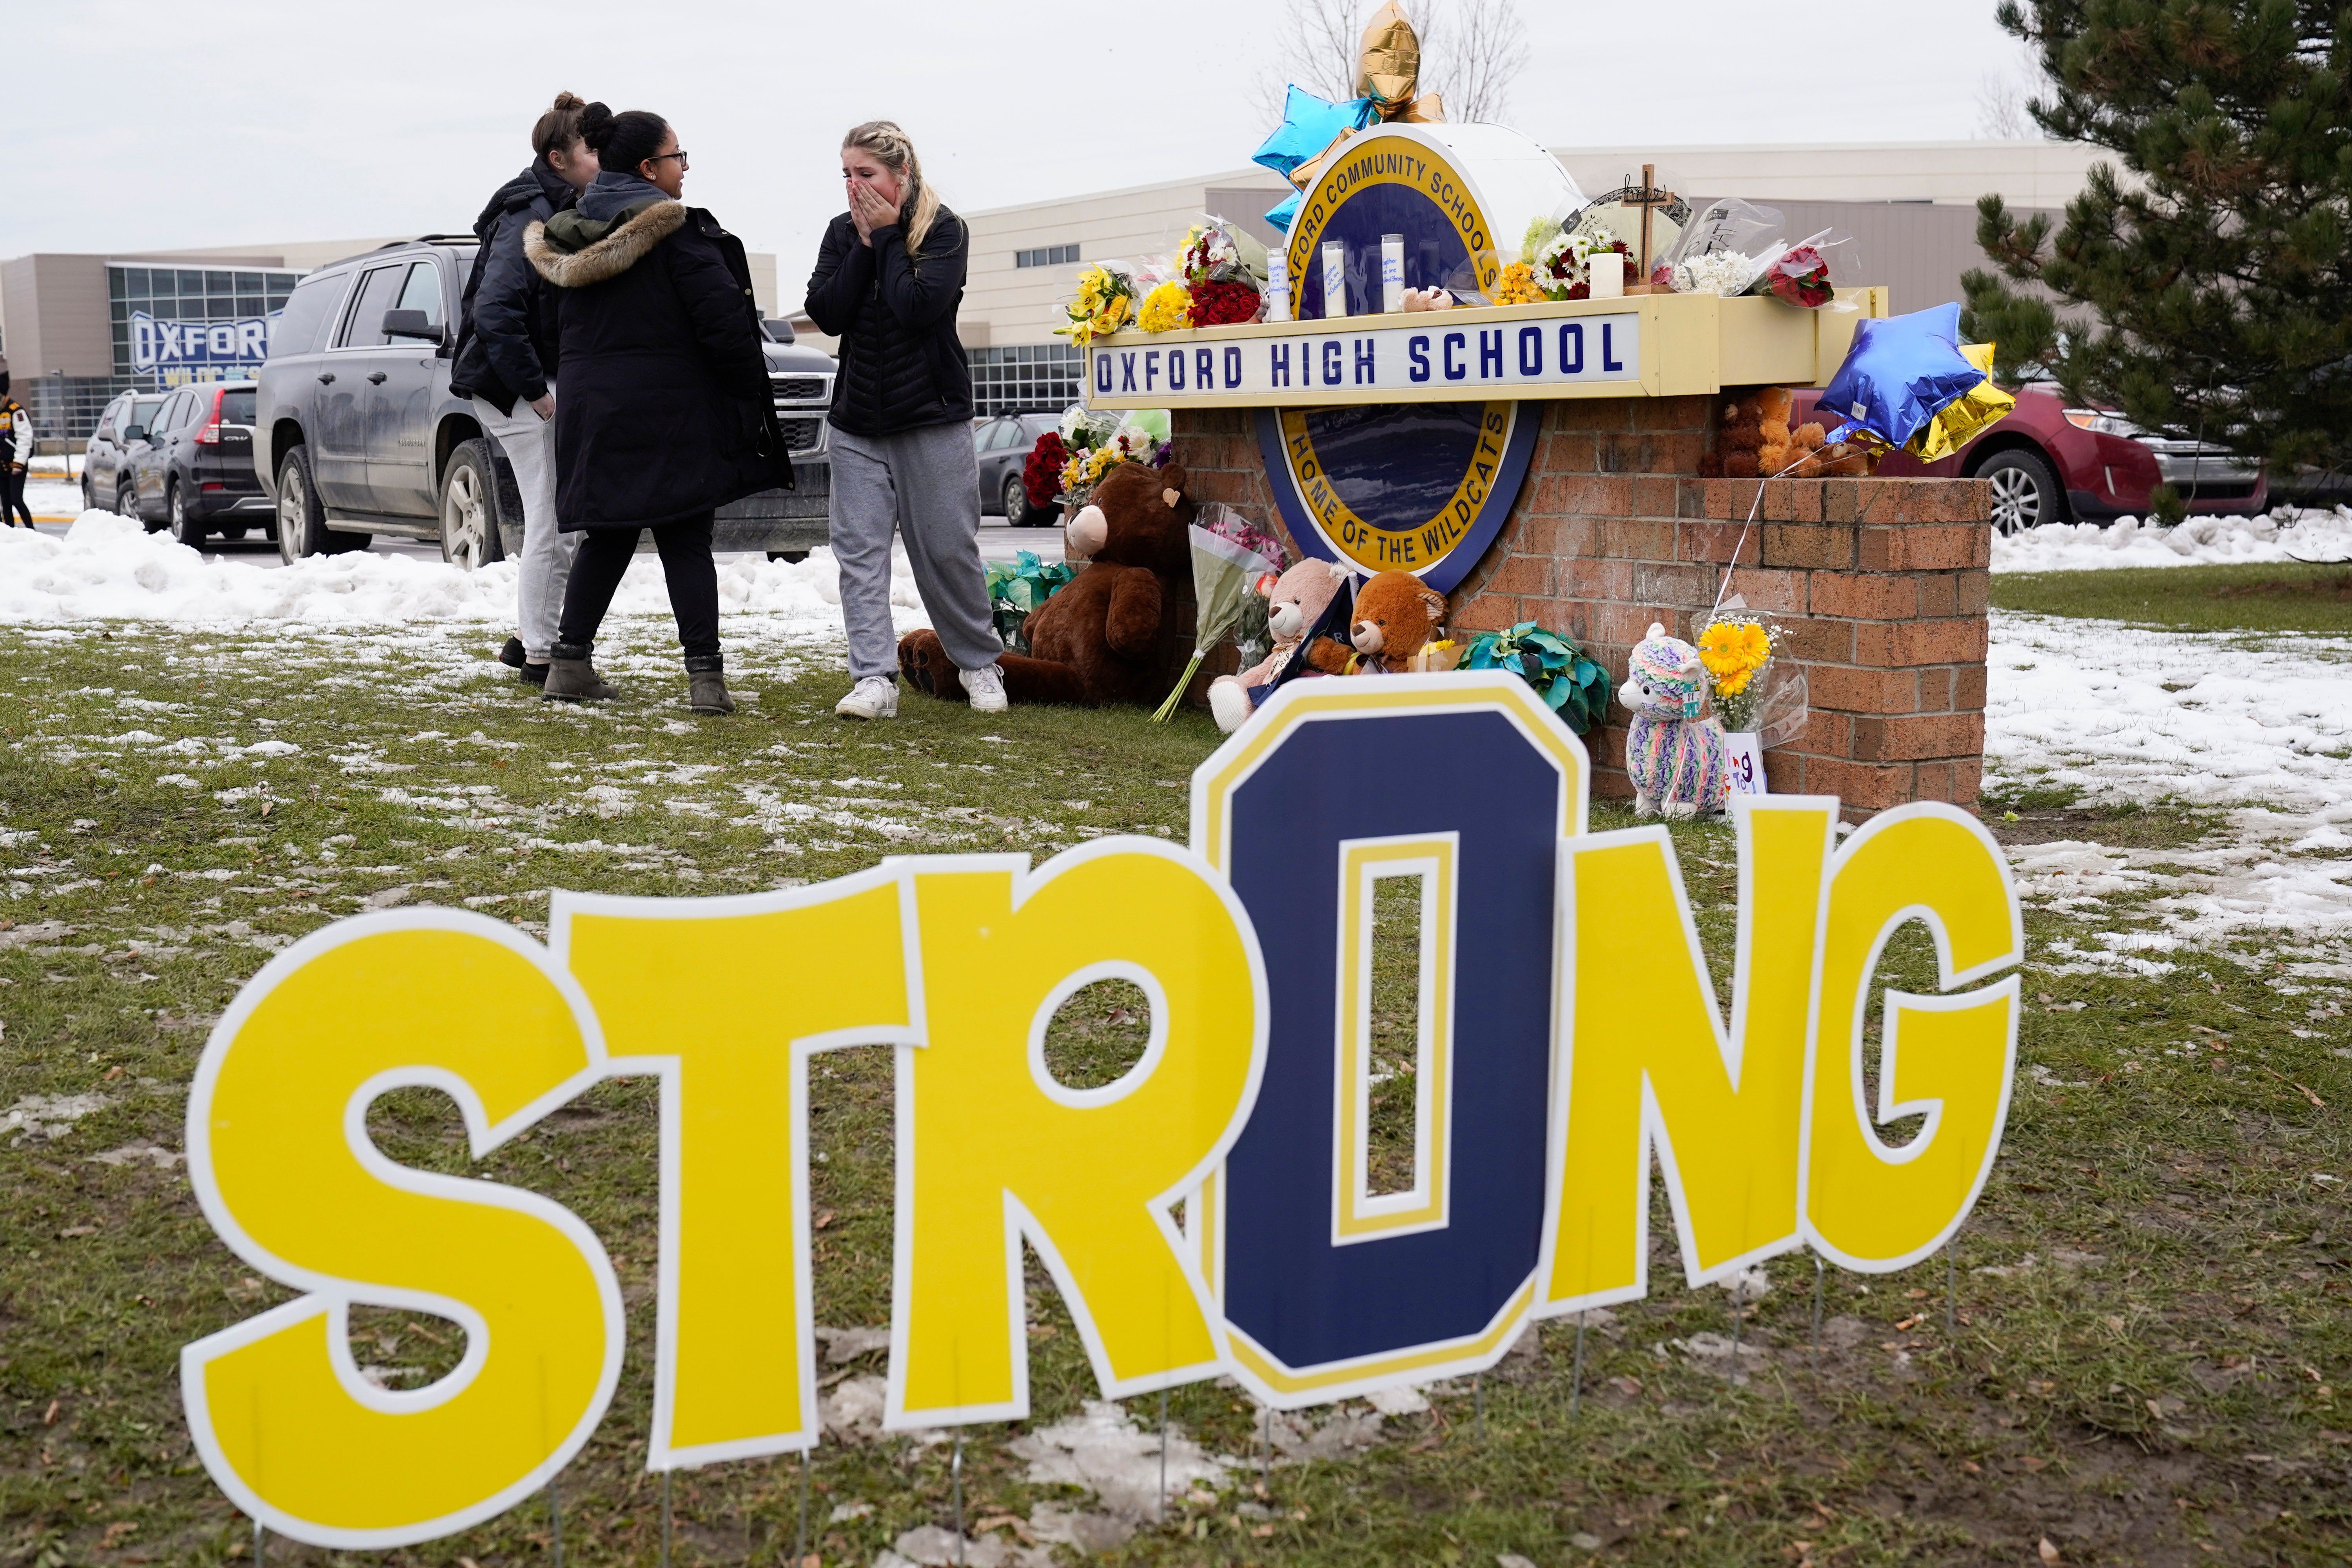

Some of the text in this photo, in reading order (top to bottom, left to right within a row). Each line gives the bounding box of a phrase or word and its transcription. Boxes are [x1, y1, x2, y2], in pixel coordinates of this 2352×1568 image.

[1289, 153, 1496, 307] OXFORD COMMUNITY SCHOOLS
[1325, 264, 1336, 281] ogether
[132, 312, 283, 370] OXFOR
[1097, 323, 1622, 392] OXFORD HIGH SCHOOL
[163, 365, 262, 389] WILDCS
[1292, 411, 1503, 563] HOME OF THE WILDCATS
[180, 672, 2024, 1551] STRONG
